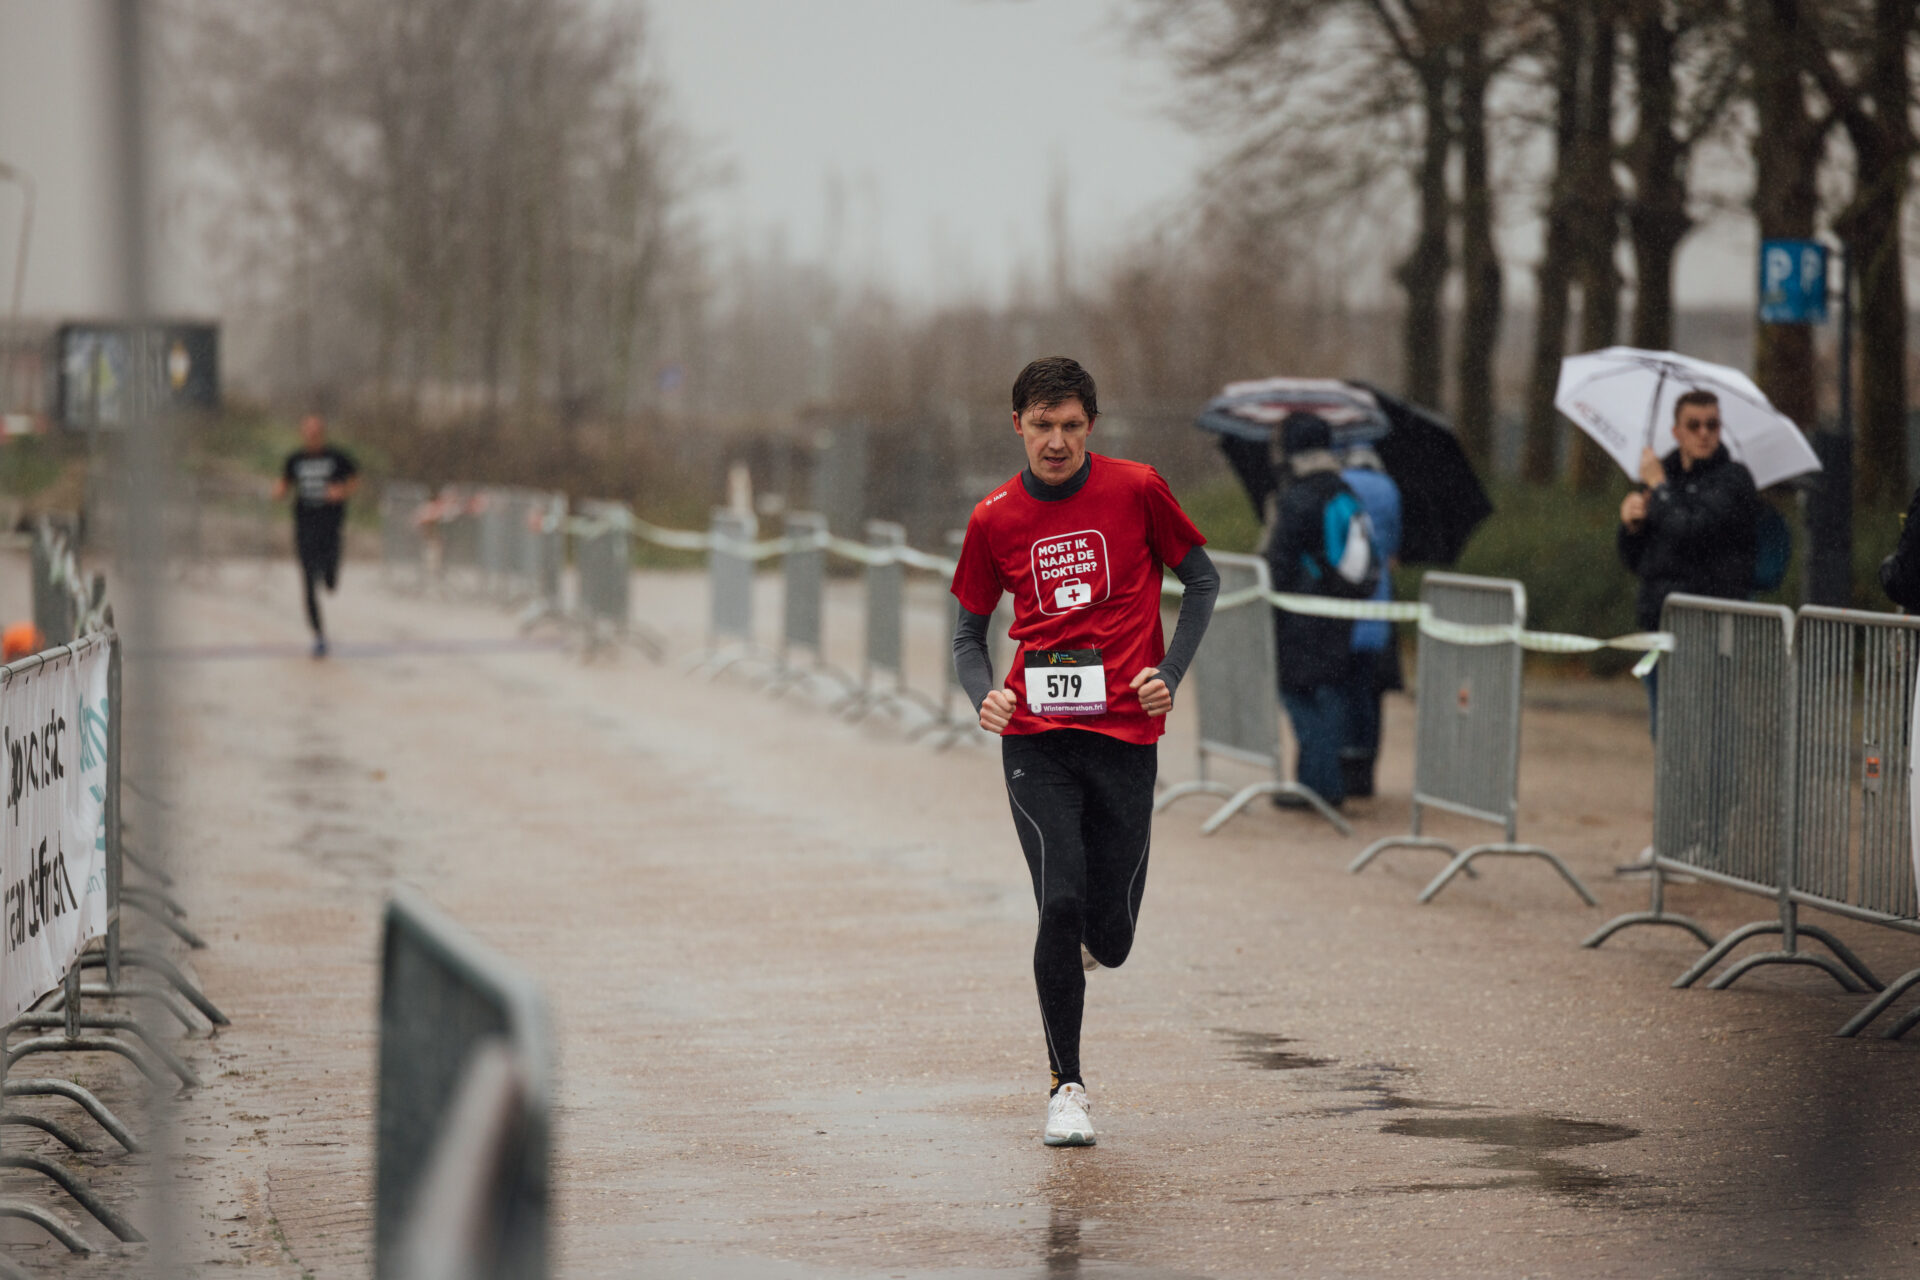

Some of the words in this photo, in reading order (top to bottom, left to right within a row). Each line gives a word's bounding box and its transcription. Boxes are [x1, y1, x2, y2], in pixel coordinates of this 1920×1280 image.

[1038, 541, 1072, 557] MOET
[1075, 538, 1088, 549] IK
[1039, 553, 1075, 568] NAAR
[1077, 549, 1095, 561] DE
[1041, 561, 1097, 580] DOKTER?
[1046, 674, 1082, 698] 579
[1043, 703, 1103, 712] Wintermarathon.frl
